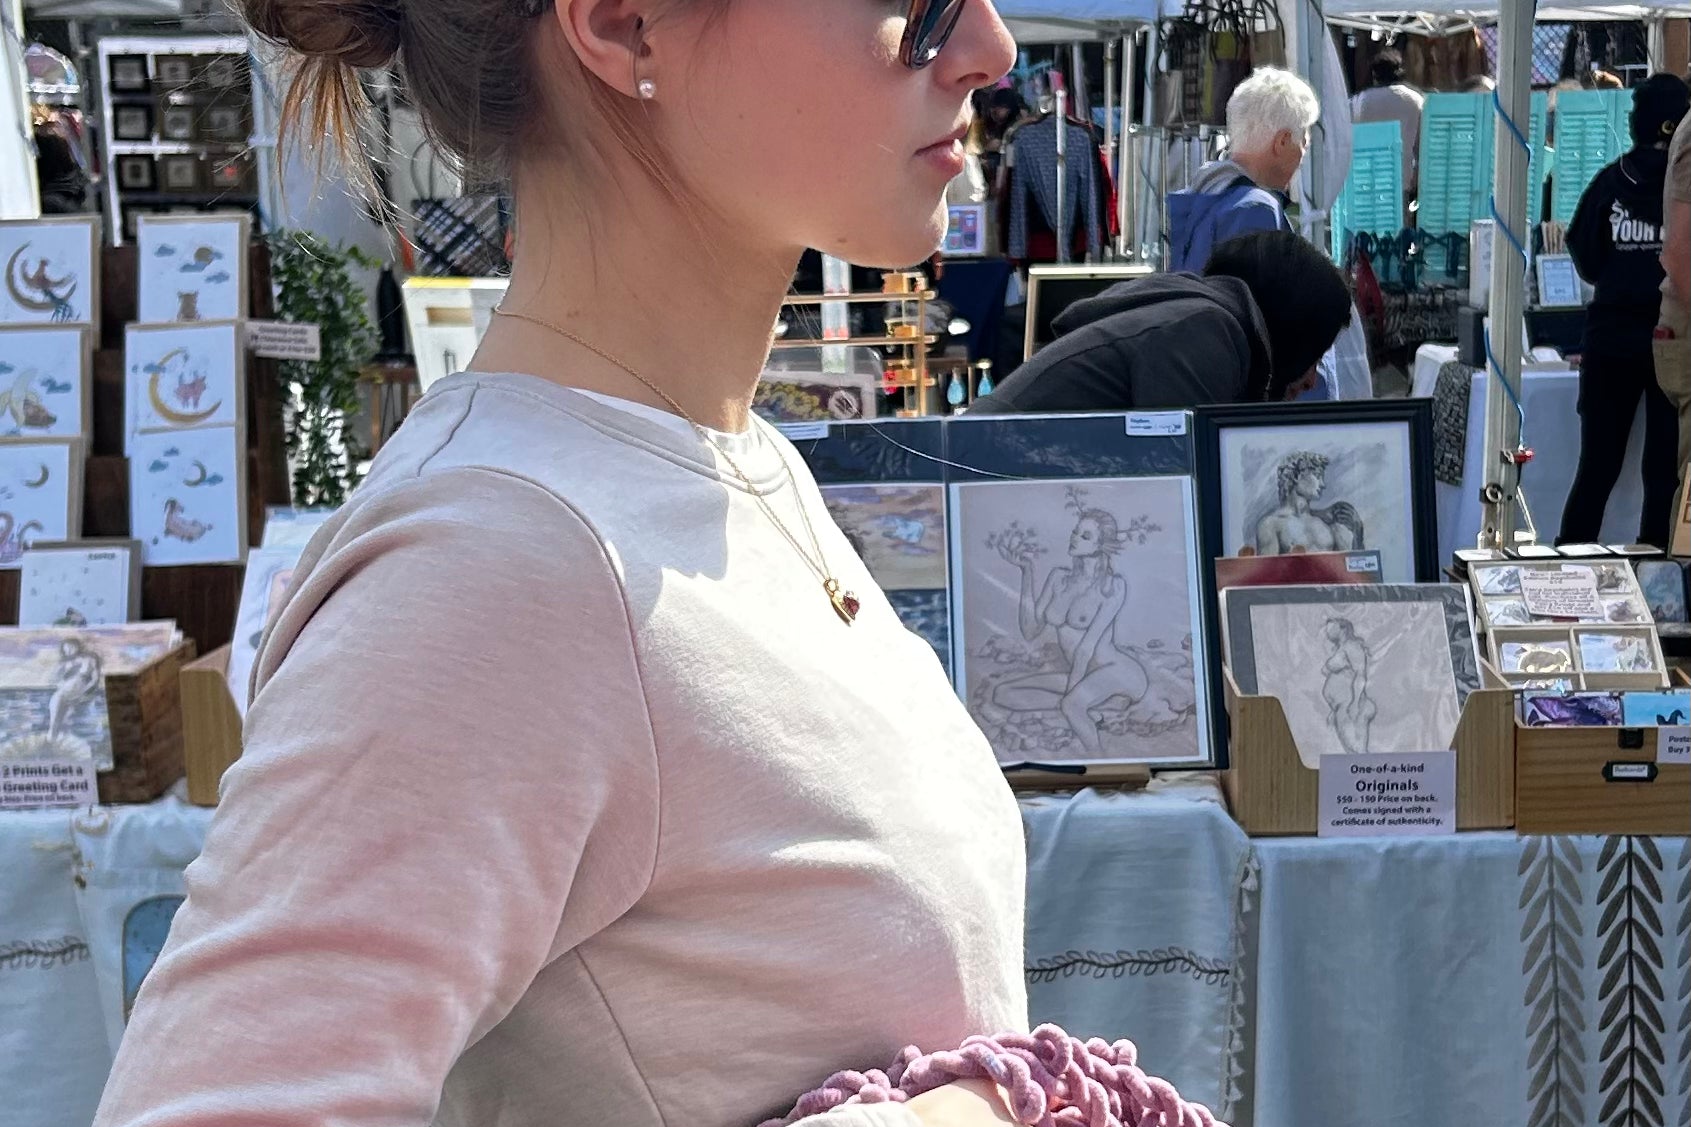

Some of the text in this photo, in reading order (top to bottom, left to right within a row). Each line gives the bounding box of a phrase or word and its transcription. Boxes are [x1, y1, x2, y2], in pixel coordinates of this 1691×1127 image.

[12, 764, 49, 777] Prints
[51, 763, 74, 777] Get
[76, 765, 83, 776] a
[1350, 763, 1424, 774] One-of-a-kind
[3, 779, 89, 793] Greeting Card
[1355, 779, 1419, 794] Originals
[1377, 794, 1399, 803] Price
[1401, 795, 1413, 803] on
[1342, 806, 1372, 815] Comes
[1373, 805, 1403, 816] signed
[1404, 805, 1424, 814] with
[1331, 817, 1375, 826] certificate
[1376, 816, 1386, 825] of
